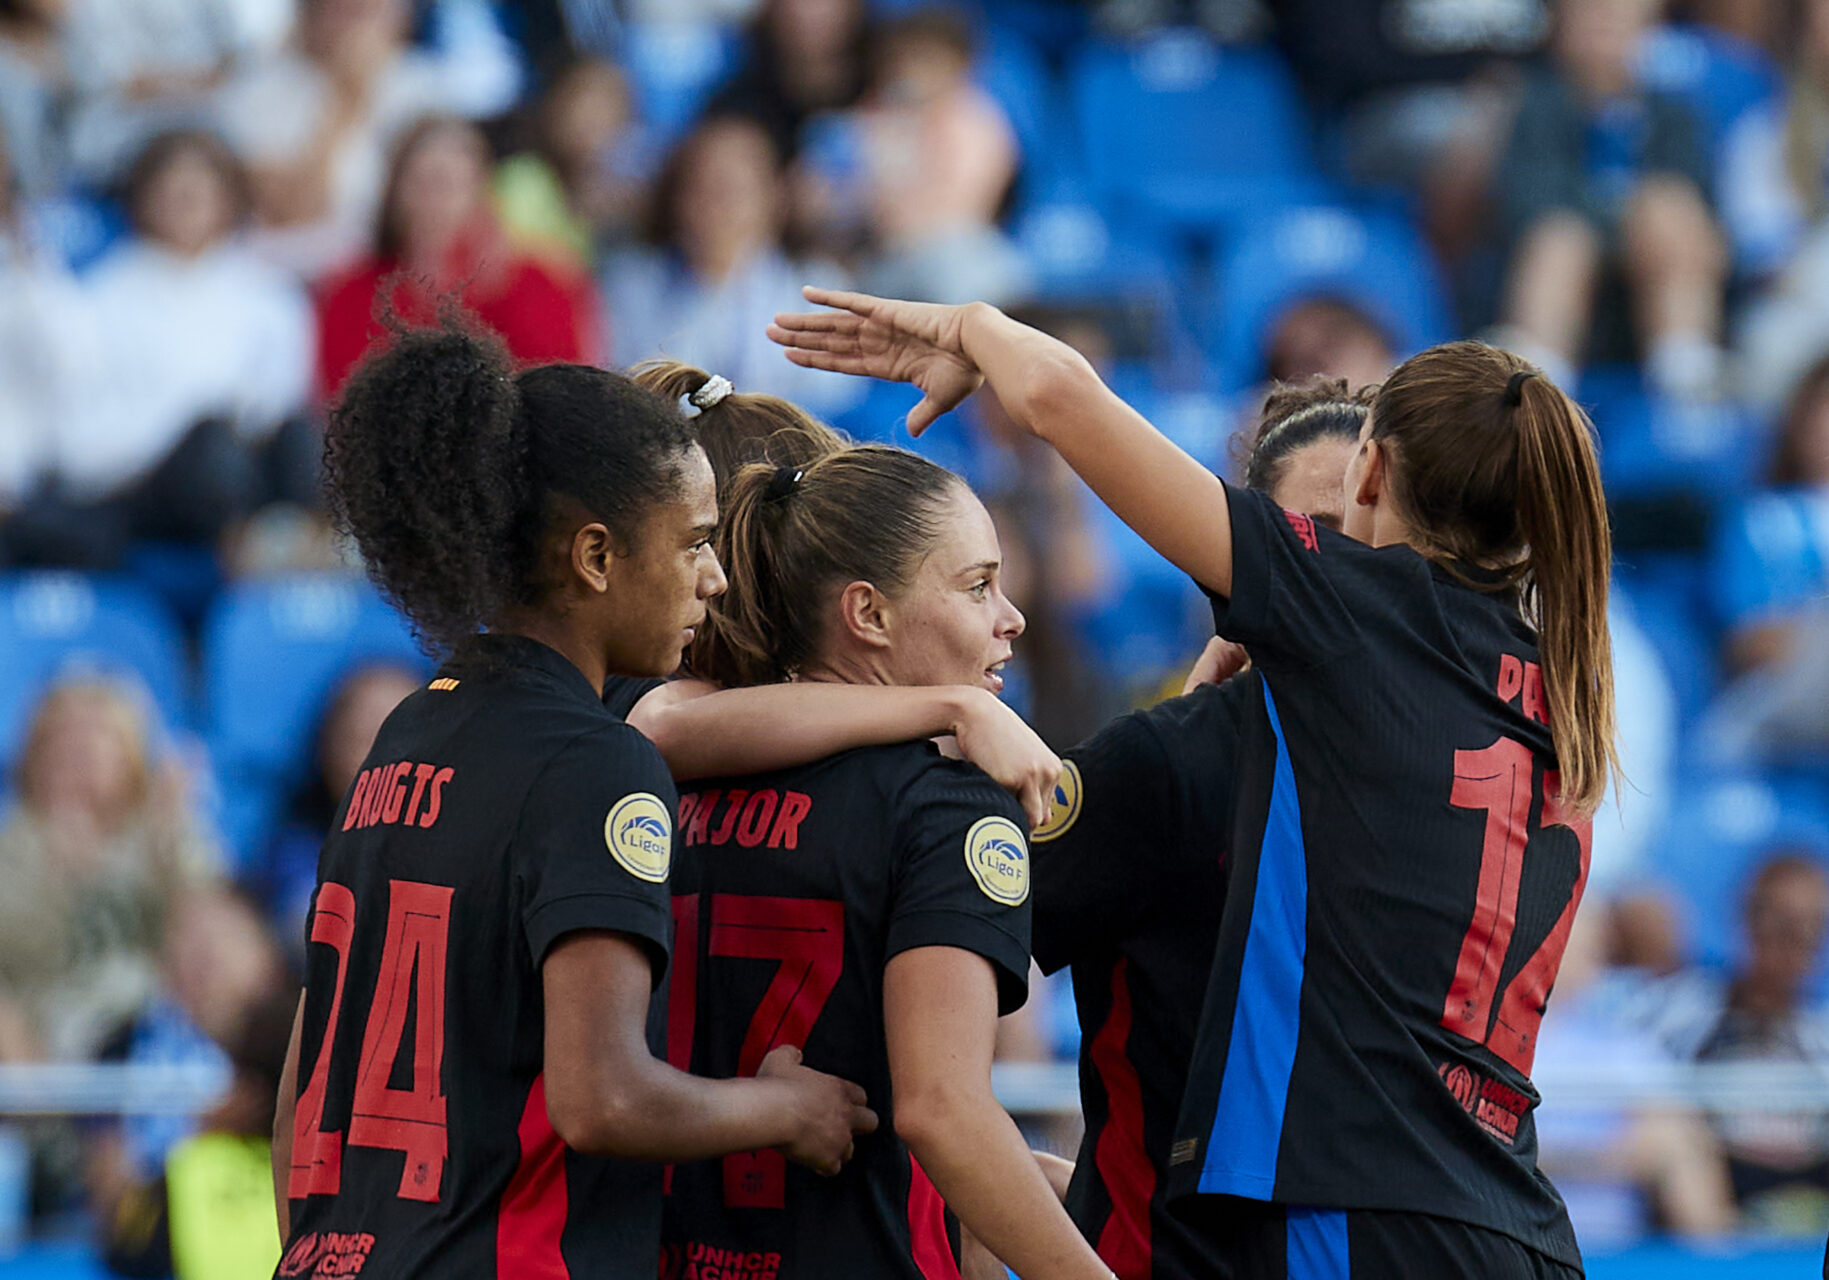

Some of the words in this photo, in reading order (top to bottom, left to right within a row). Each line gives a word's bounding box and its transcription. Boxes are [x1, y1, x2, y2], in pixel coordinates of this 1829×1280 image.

[342, 761, 455, 832] BRUGTS
[677, 787, 813, 852] PAJOR
[987, 855, 1014, 876] Liga
[1015, 869, 1023, 881] F
[1440, 735, 1594, 1079] 12
[288, 878, 456, 1202] 24
[686, 1241, 782, 1271] UNHCR
